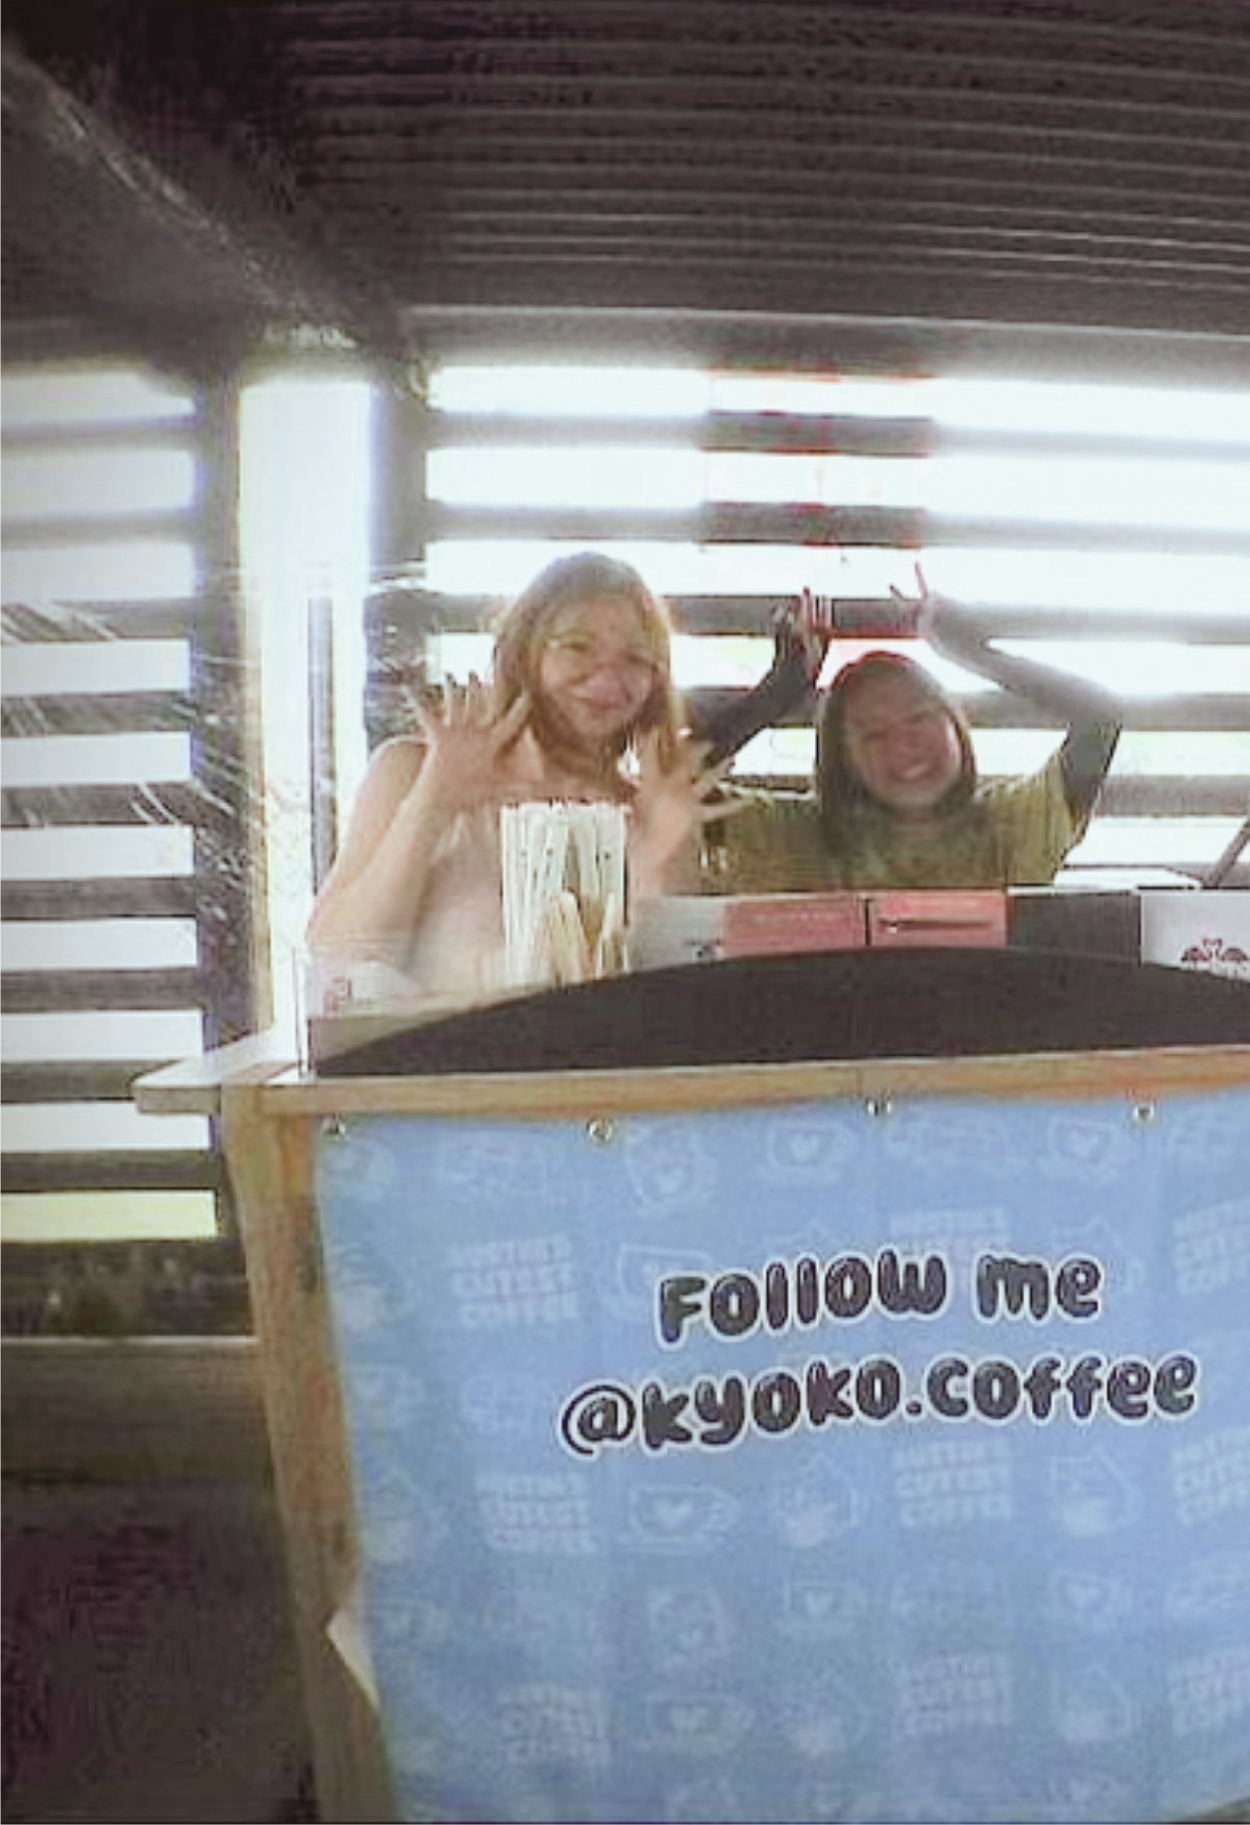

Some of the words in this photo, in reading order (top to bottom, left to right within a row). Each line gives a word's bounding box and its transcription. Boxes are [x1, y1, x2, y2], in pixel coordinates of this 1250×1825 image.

[657, 1246, 949, 1347] Follow
[973, 1251, 1102, 1323] me
[558, 1352, 1199, 1459] @kyoko.coffee
